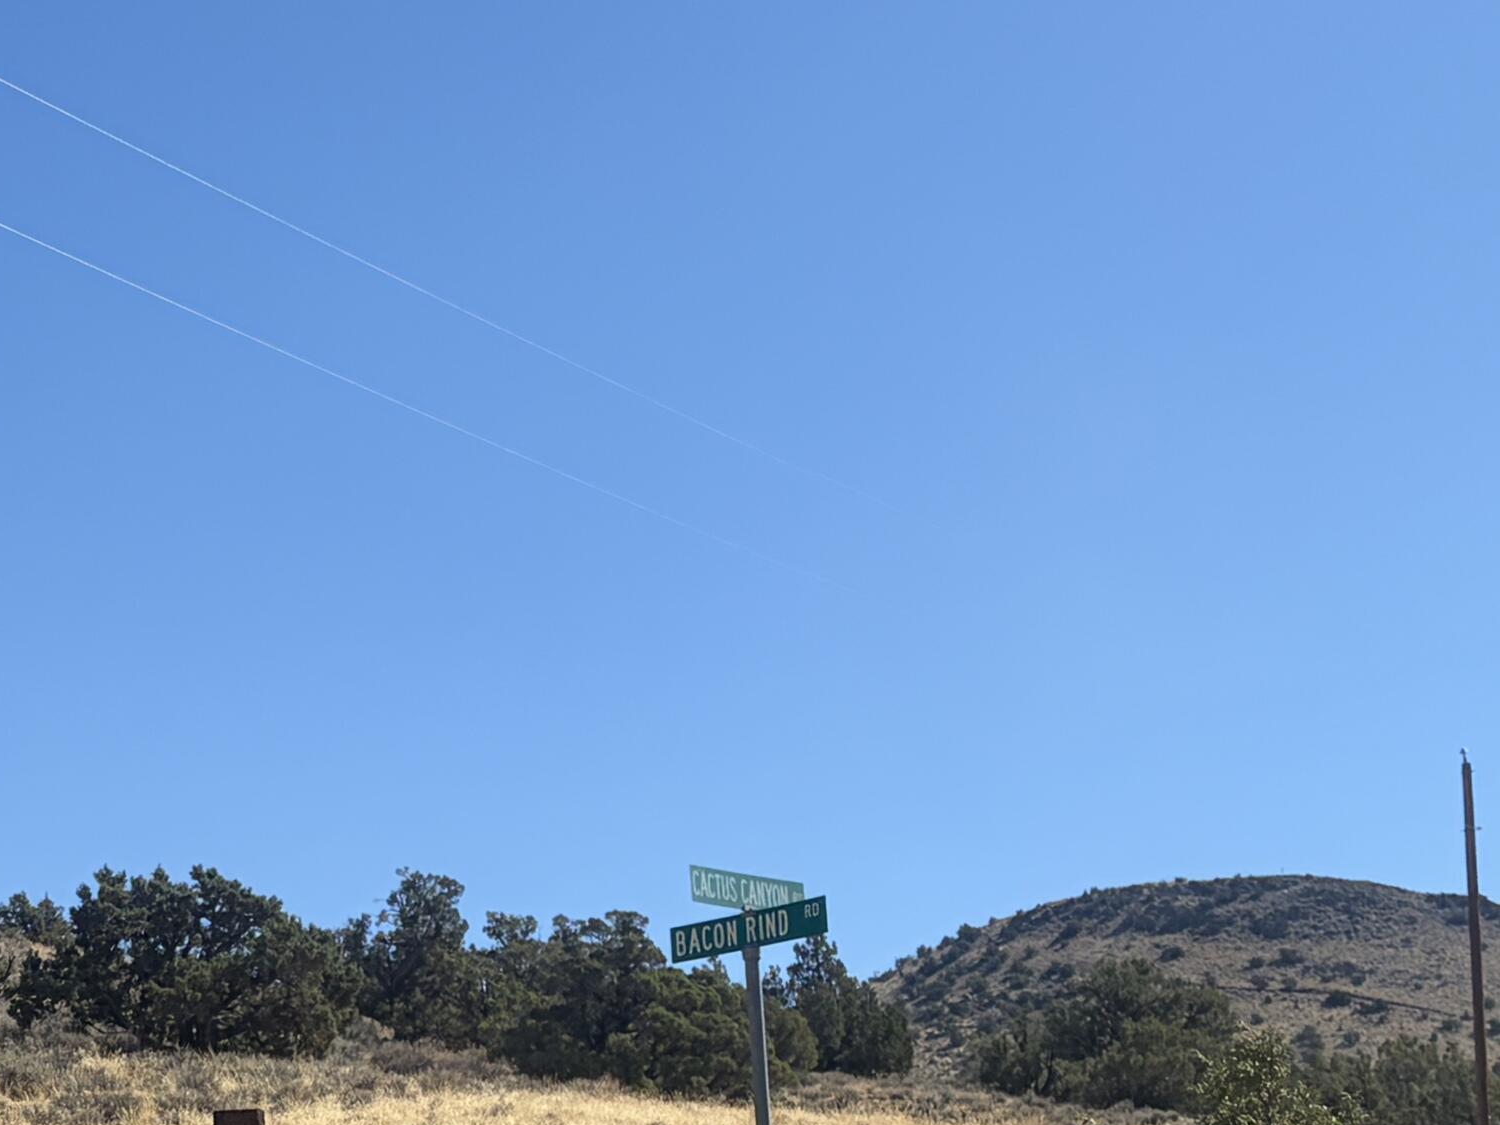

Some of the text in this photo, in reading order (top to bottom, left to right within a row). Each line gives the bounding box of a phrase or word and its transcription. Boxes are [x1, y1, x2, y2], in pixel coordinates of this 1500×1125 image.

[691, 869, 738, 903] CACTUS
[740, 878, 789, 908] CANYON
[675, 902, 820, 957] BACON RIND RD
